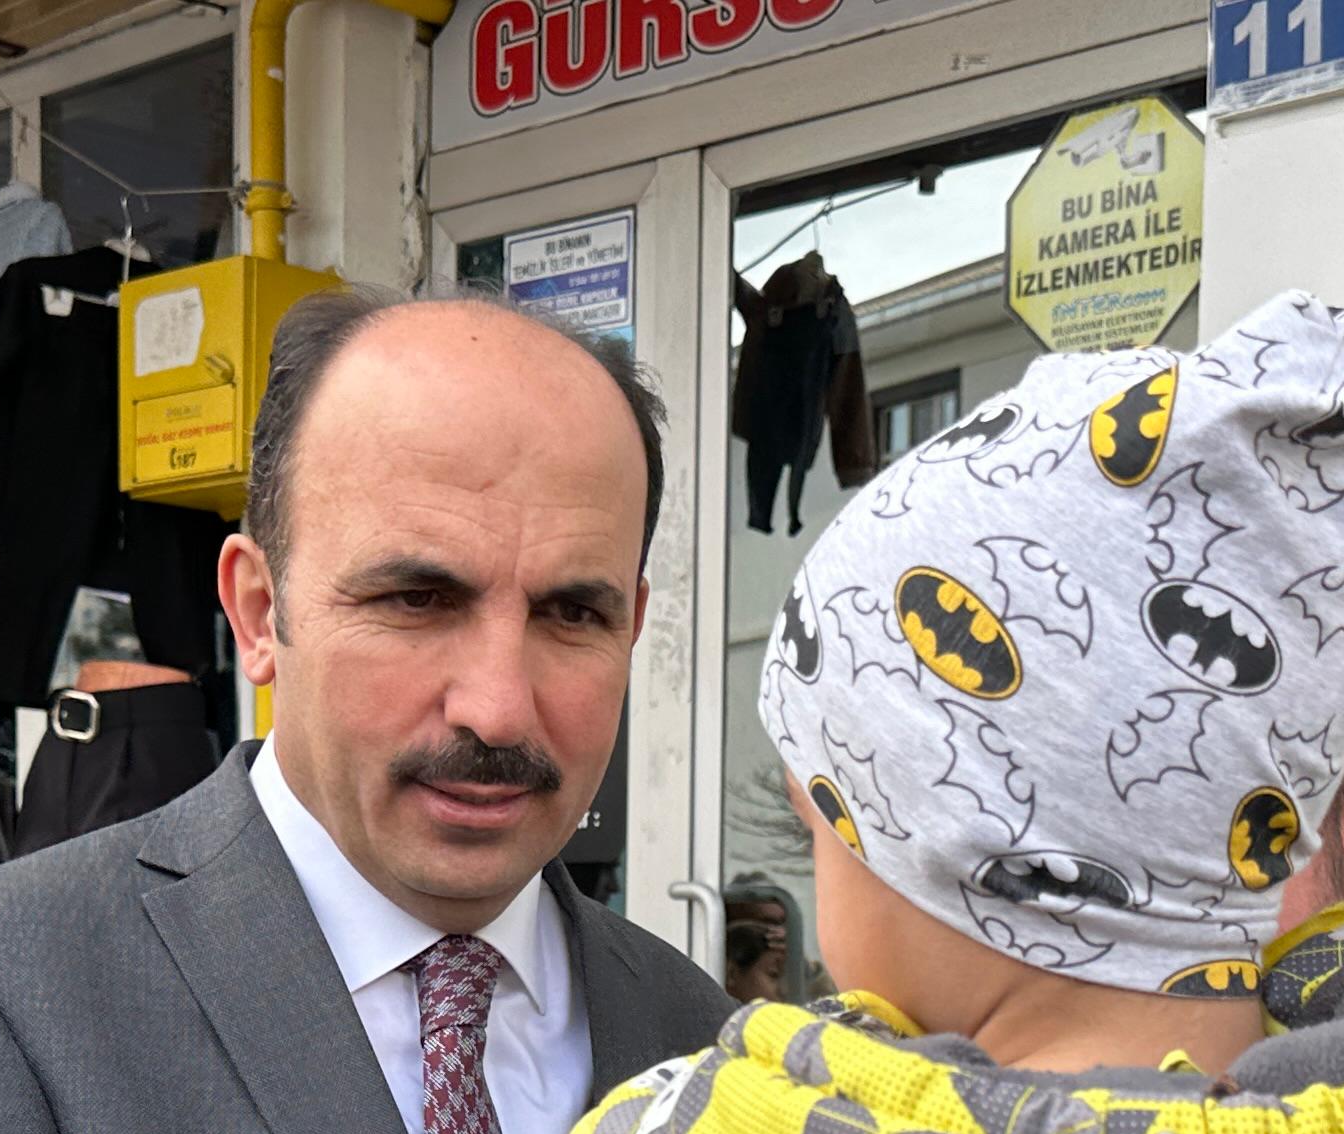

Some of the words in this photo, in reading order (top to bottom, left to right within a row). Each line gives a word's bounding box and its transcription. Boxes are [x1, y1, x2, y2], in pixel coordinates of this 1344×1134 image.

[1232, 0, 1323, 79] 11
[1061, 193, 1093, 223] BU
[1100, 179, 1158, 214] BİNA
[1038, 218, 1137, 261] KAMERA
[1144, 207, 1182, 238] İLE
[1015, 235, 1202, 299] İZLENMEKTEDİR
